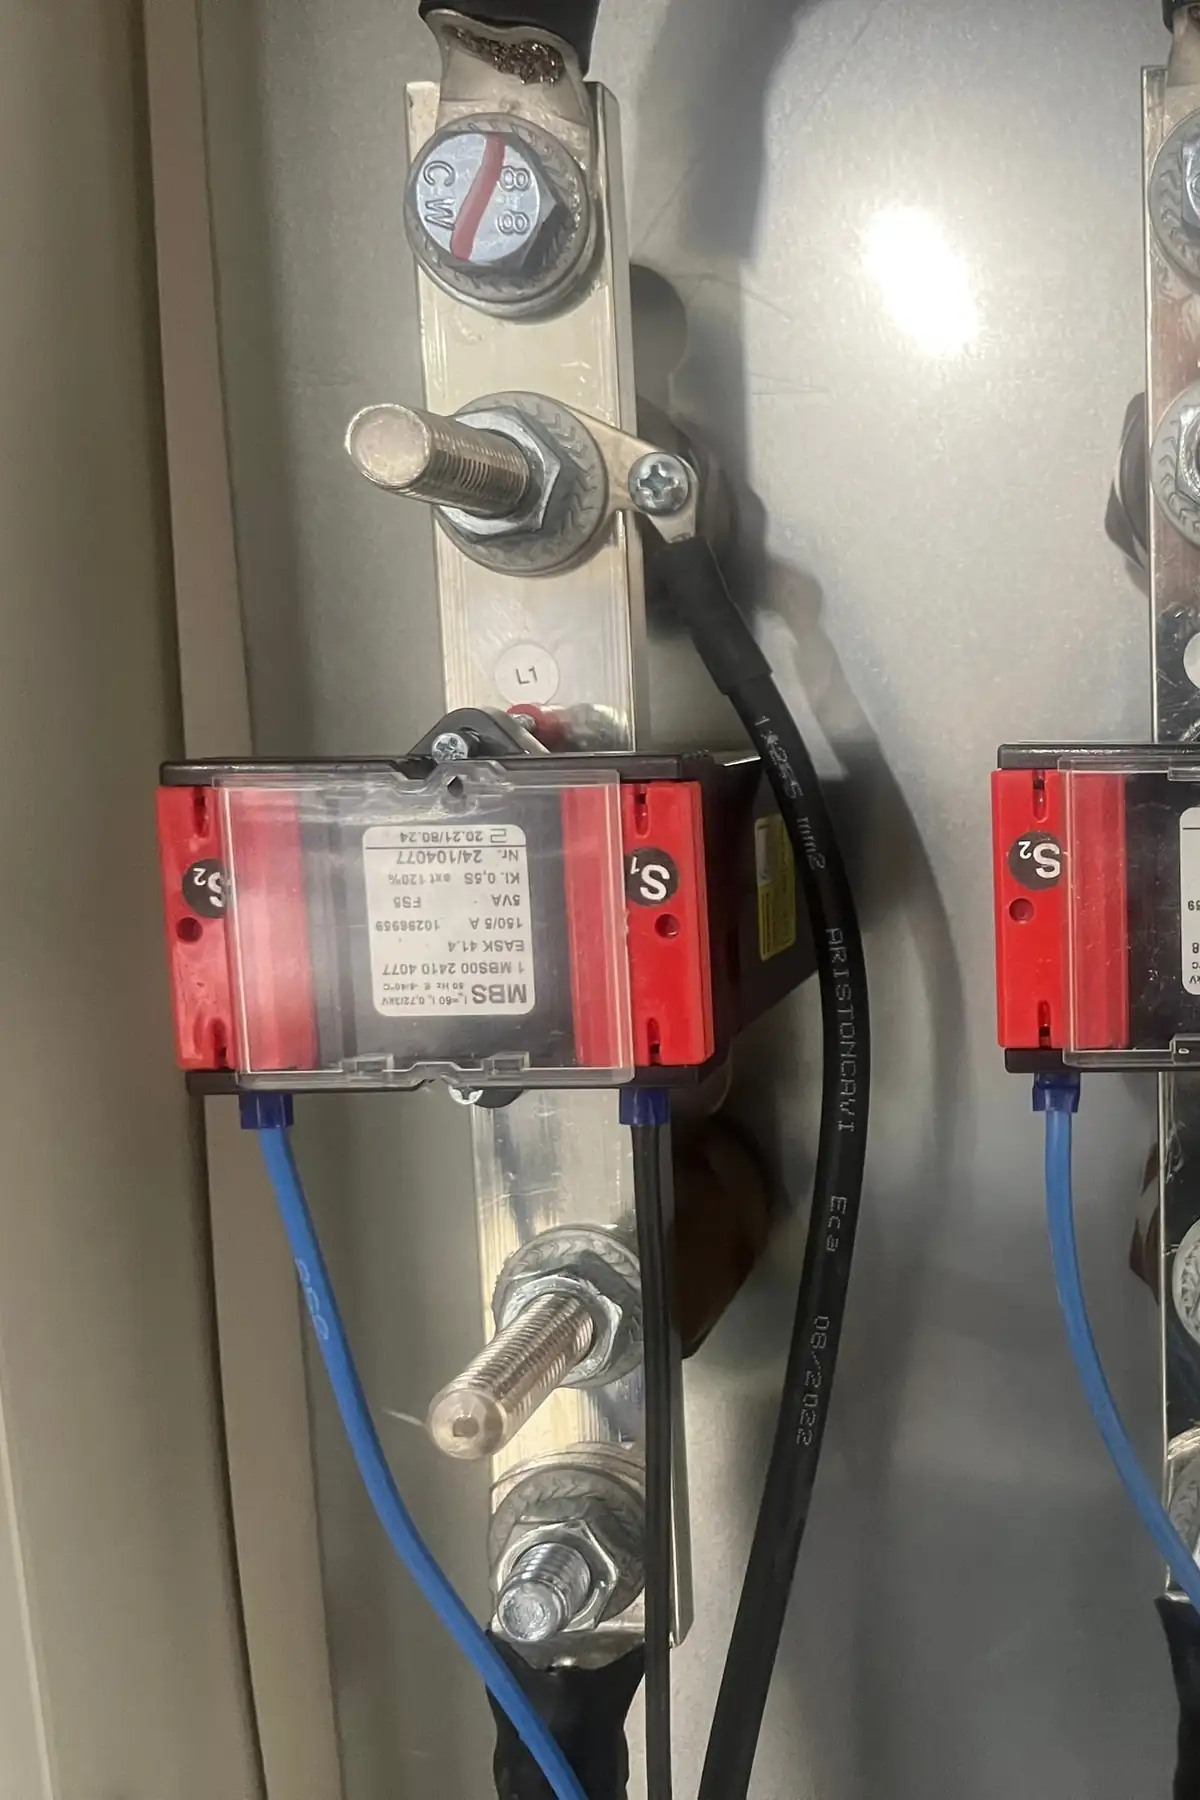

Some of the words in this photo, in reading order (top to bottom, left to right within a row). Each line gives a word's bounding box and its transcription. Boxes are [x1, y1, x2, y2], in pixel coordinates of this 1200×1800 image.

[423, 160, 456, 231] CW
[515, 666, 538, 685] L1
[400, 831, 483, 842] 20.21/80.24
[396, 850, 483, 864] 24/104077
[498, 850, 518, 861] Nr.
[1018, 841, 1060, 878] S2
[388, 874, 424, 885] 120%
[430, 874, 450, 883] ext
[630, 856, 670, 901] S1
[393, 897, 421, 908] FS5
[491, 894, 520, 906] 5VA
[375, 920, 440, 931] 10296959
[469, 918, 480, 929] A
[485, 918, 523, 929] 150/5
[448, 940, 478, 952] 41.4
[483, 940, 524, 952] EASK
[382, 963, 416, 975] 4077
[422, 963, 455, 974] 2410
[462, 962, 512, 974] MBS00
[518, 962, 525, 973] 1
[471, 984, 527, 1004] MBS
[824, 928, 857, 1133] ARISTONCAVI
[826, 1195, 848, 1253] Eca
